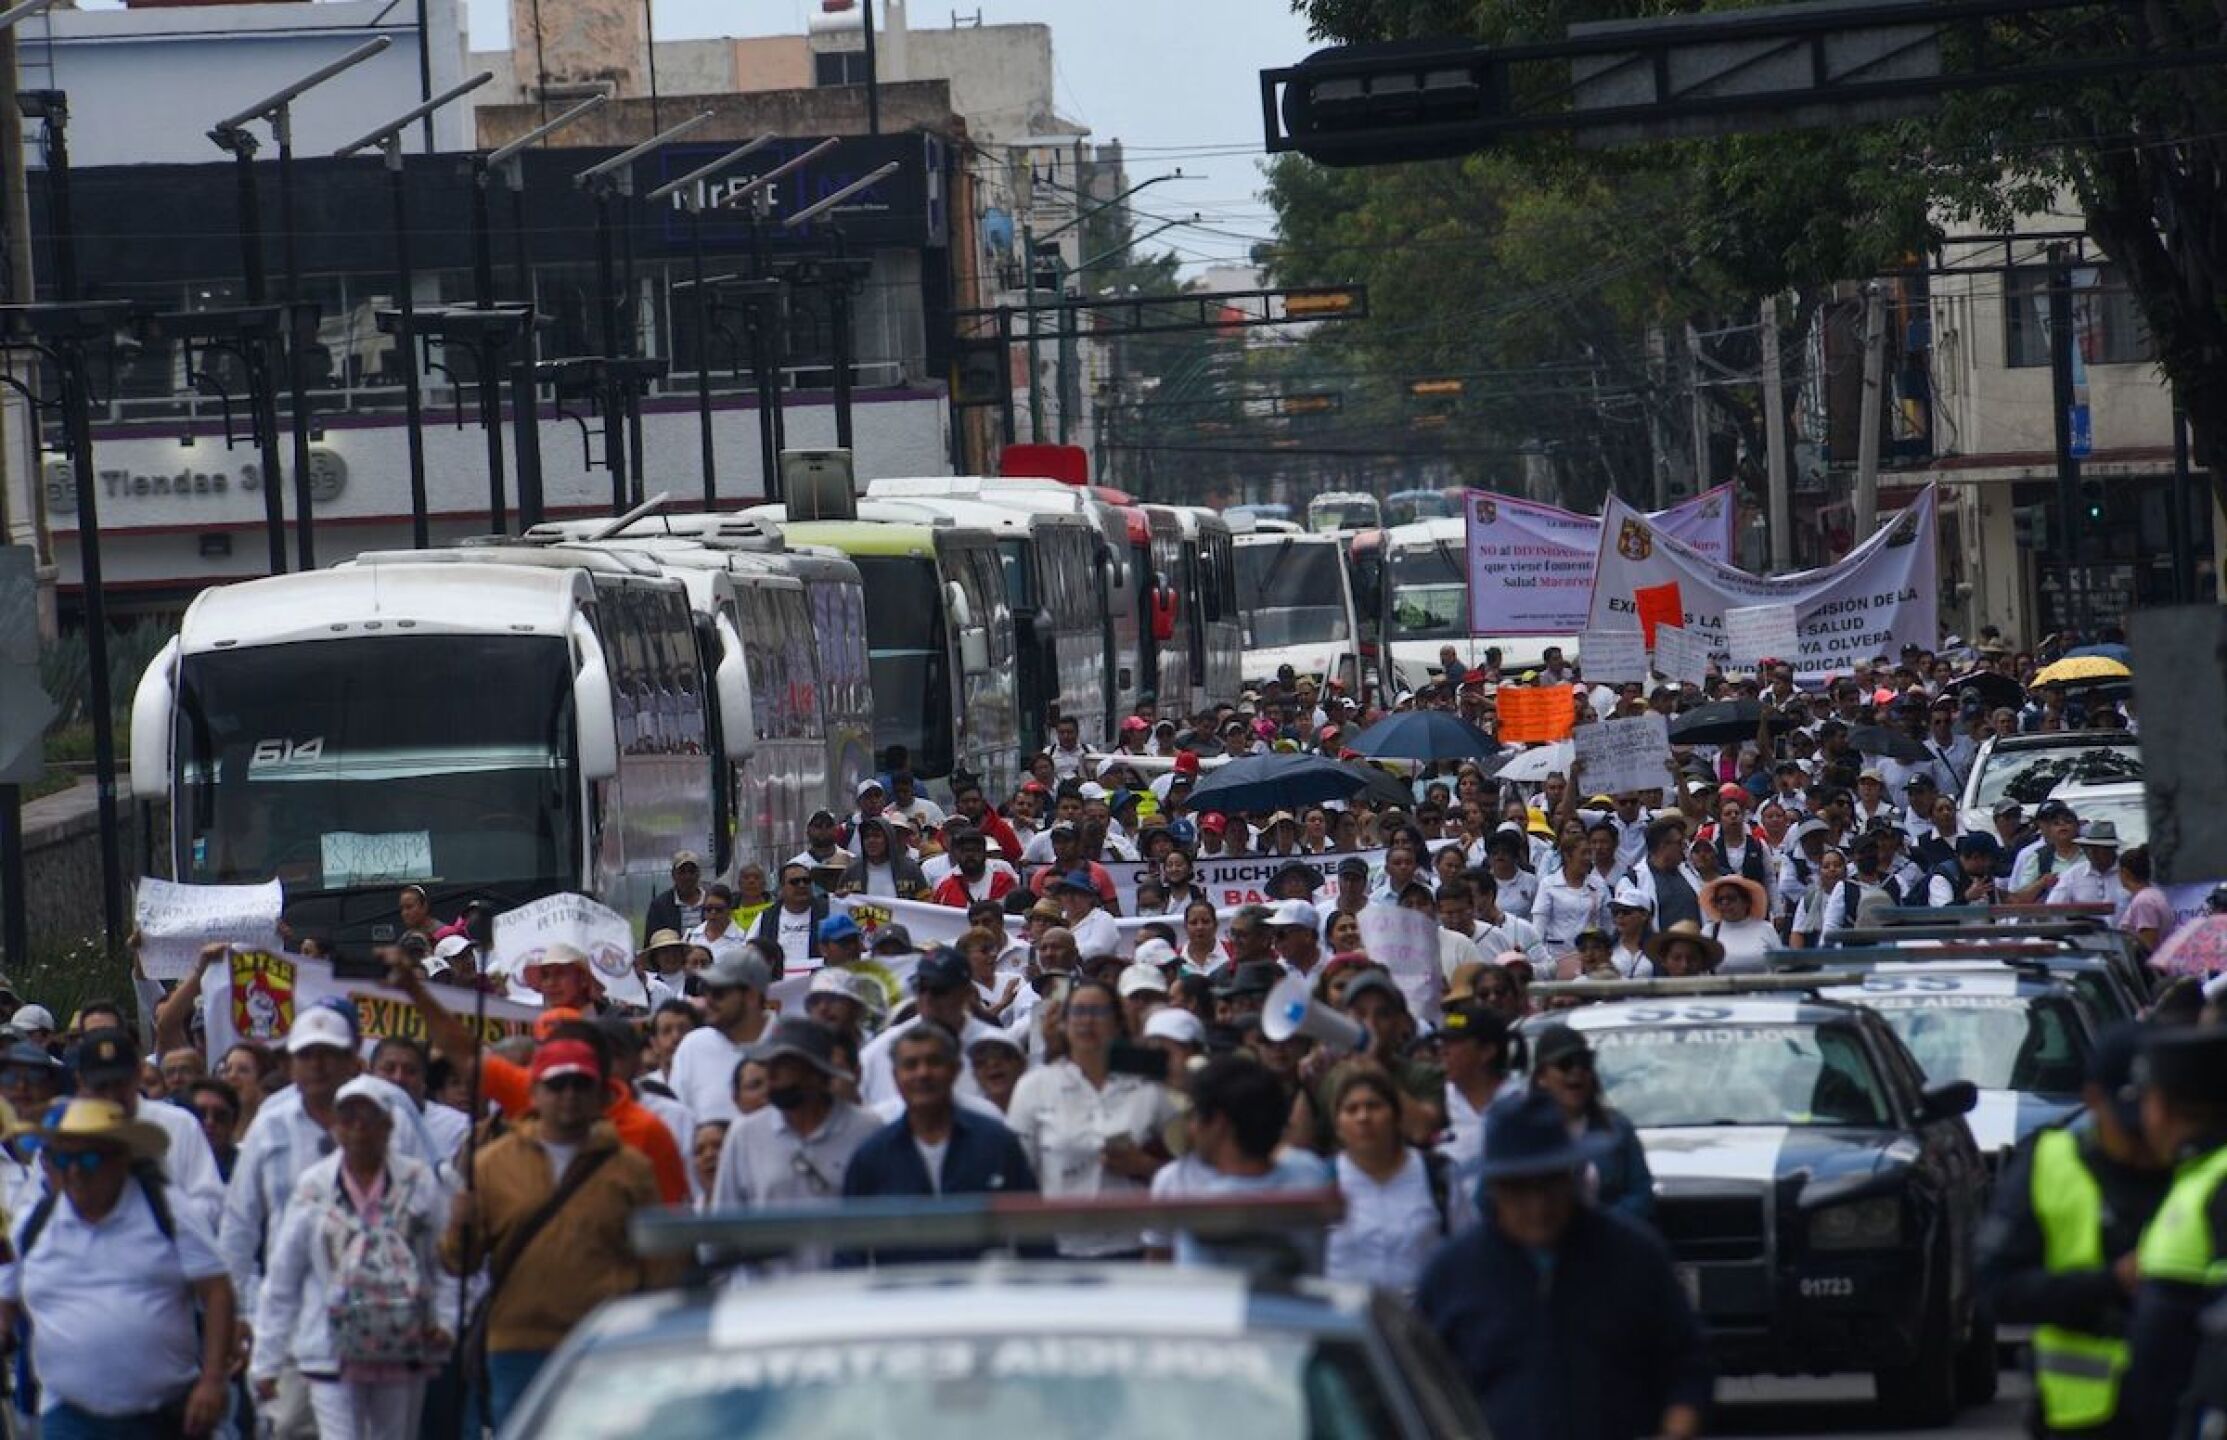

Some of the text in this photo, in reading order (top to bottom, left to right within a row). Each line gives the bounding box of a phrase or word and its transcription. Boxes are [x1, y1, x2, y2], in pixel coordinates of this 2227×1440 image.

[101, 468, 228, 498] Tiendas
[1504, 576, 1594, 588] Salud Macaren
[1873, 591, 1895, 608] DE
[1898, 587, 1918, 602] LA
[1701, 615, 1722, 629] LA
[1808, 617, 1864, 636] SALUD
[1828, 630, 1892, 651] OLVERA
